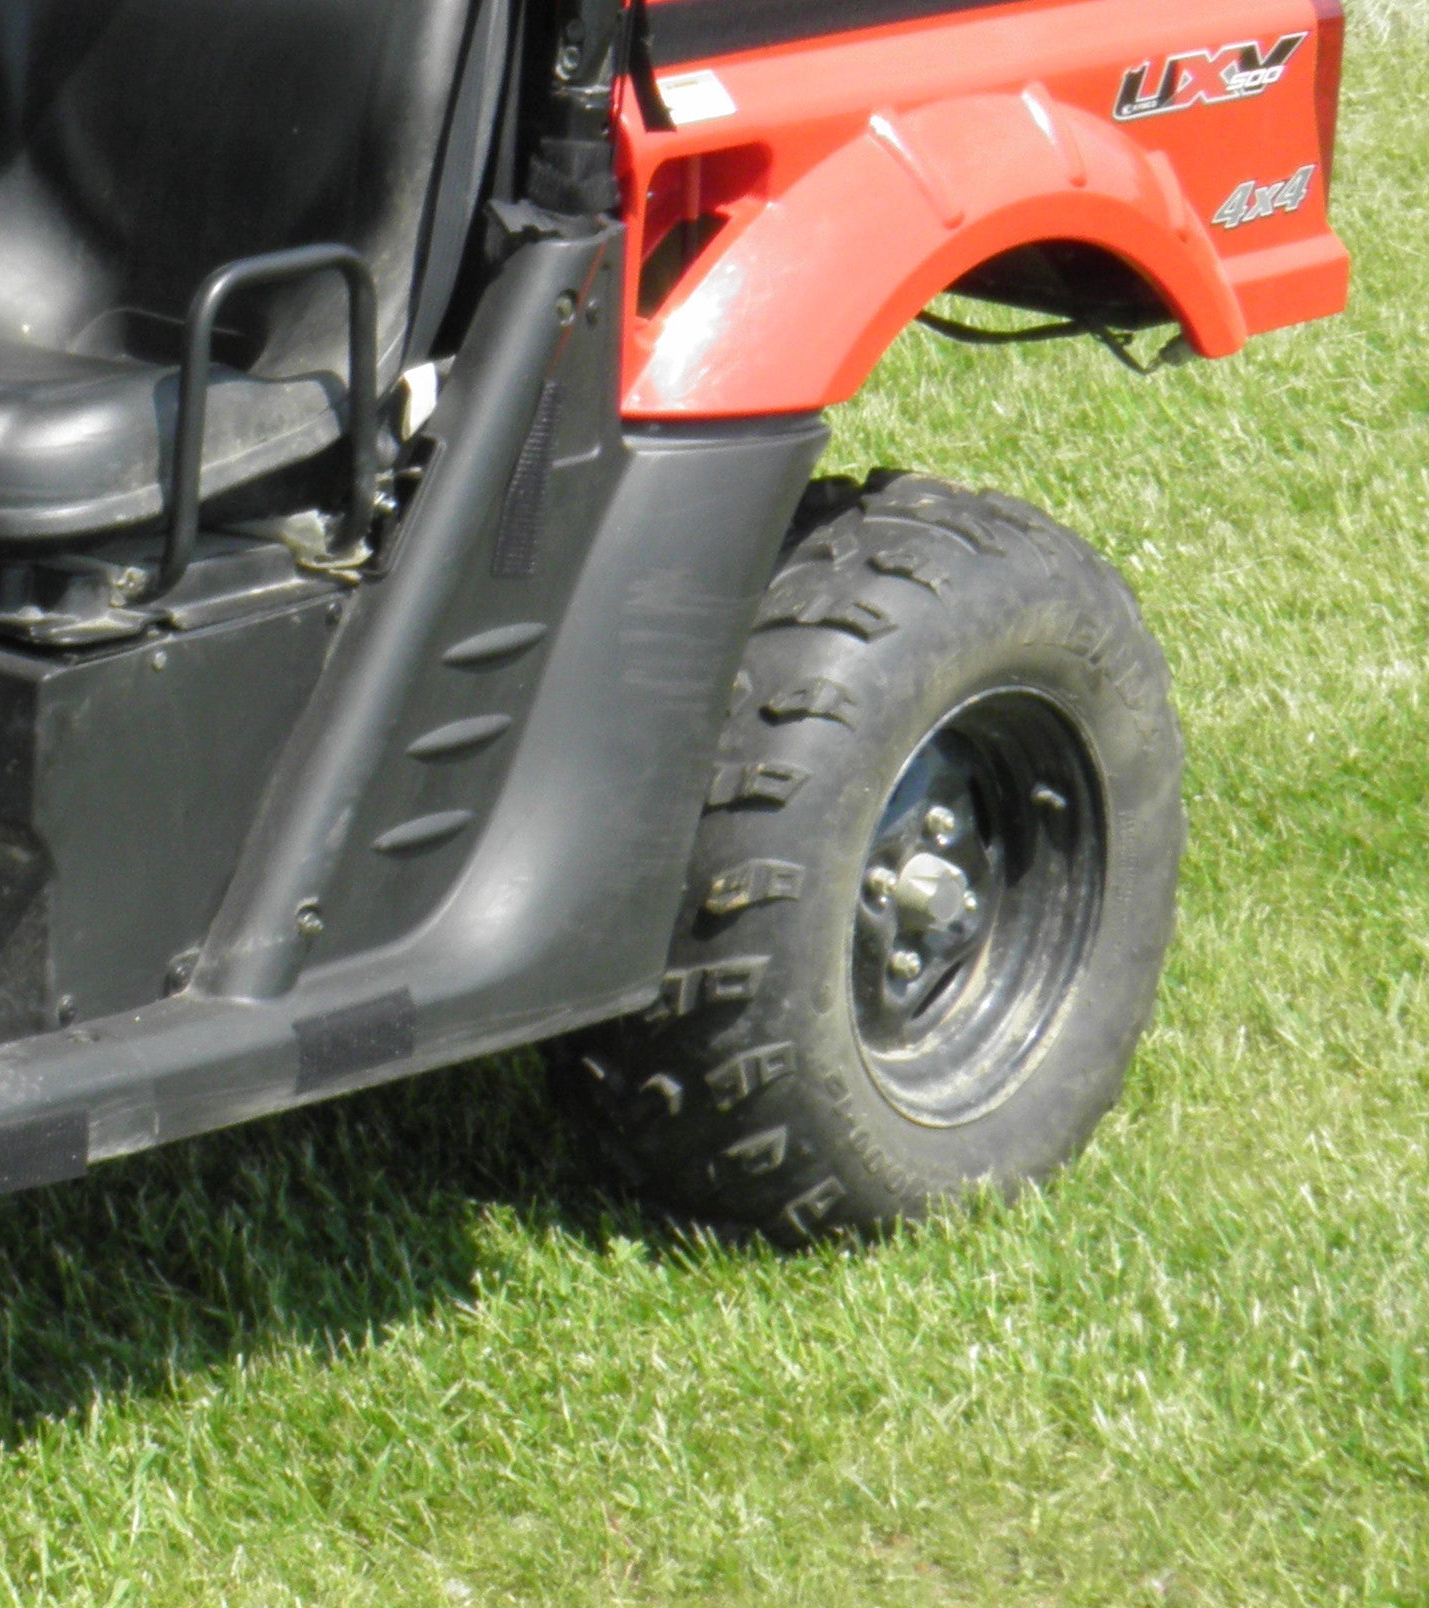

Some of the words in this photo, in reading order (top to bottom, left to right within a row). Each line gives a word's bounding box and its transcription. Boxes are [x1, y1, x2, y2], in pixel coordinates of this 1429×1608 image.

[1113, 32, 1309, 121] UXV
[1225, 65, 1286, 92] 500
[1211, 164, 1316, 230] 4x4
